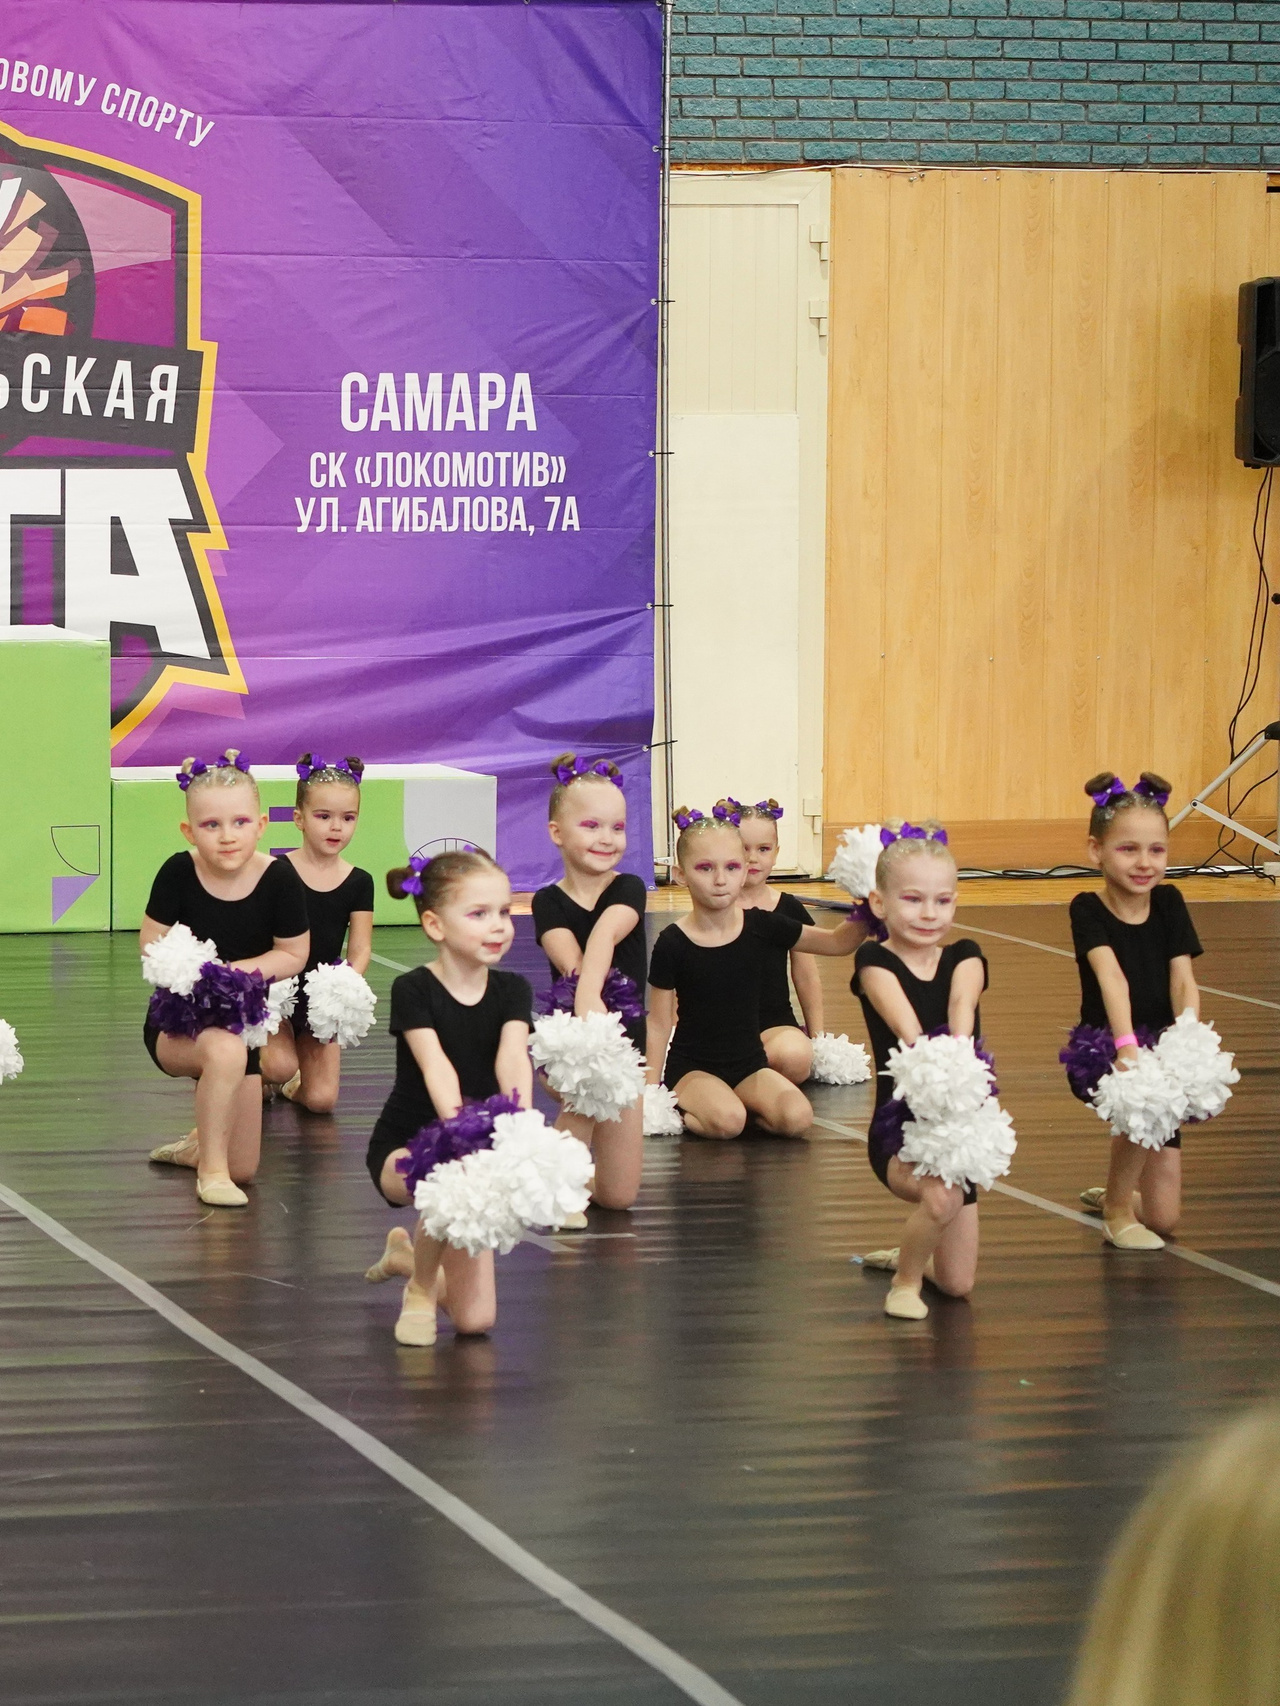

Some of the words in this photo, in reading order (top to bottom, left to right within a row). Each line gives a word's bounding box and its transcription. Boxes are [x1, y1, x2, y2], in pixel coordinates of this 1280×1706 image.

[100, 82, 216, 149] СПОРТУ
[339, 371, 538, 432] САМАРА
[309, 451, 348, 488] СК
[354, 451, 567, 488] «ЛОКОМОТИВ»
[294, 496, 347, 533] УЛ.
[355, 495, 536, 537] АГИБАЛОВА,
[544, 495, 581, 533] 7А
